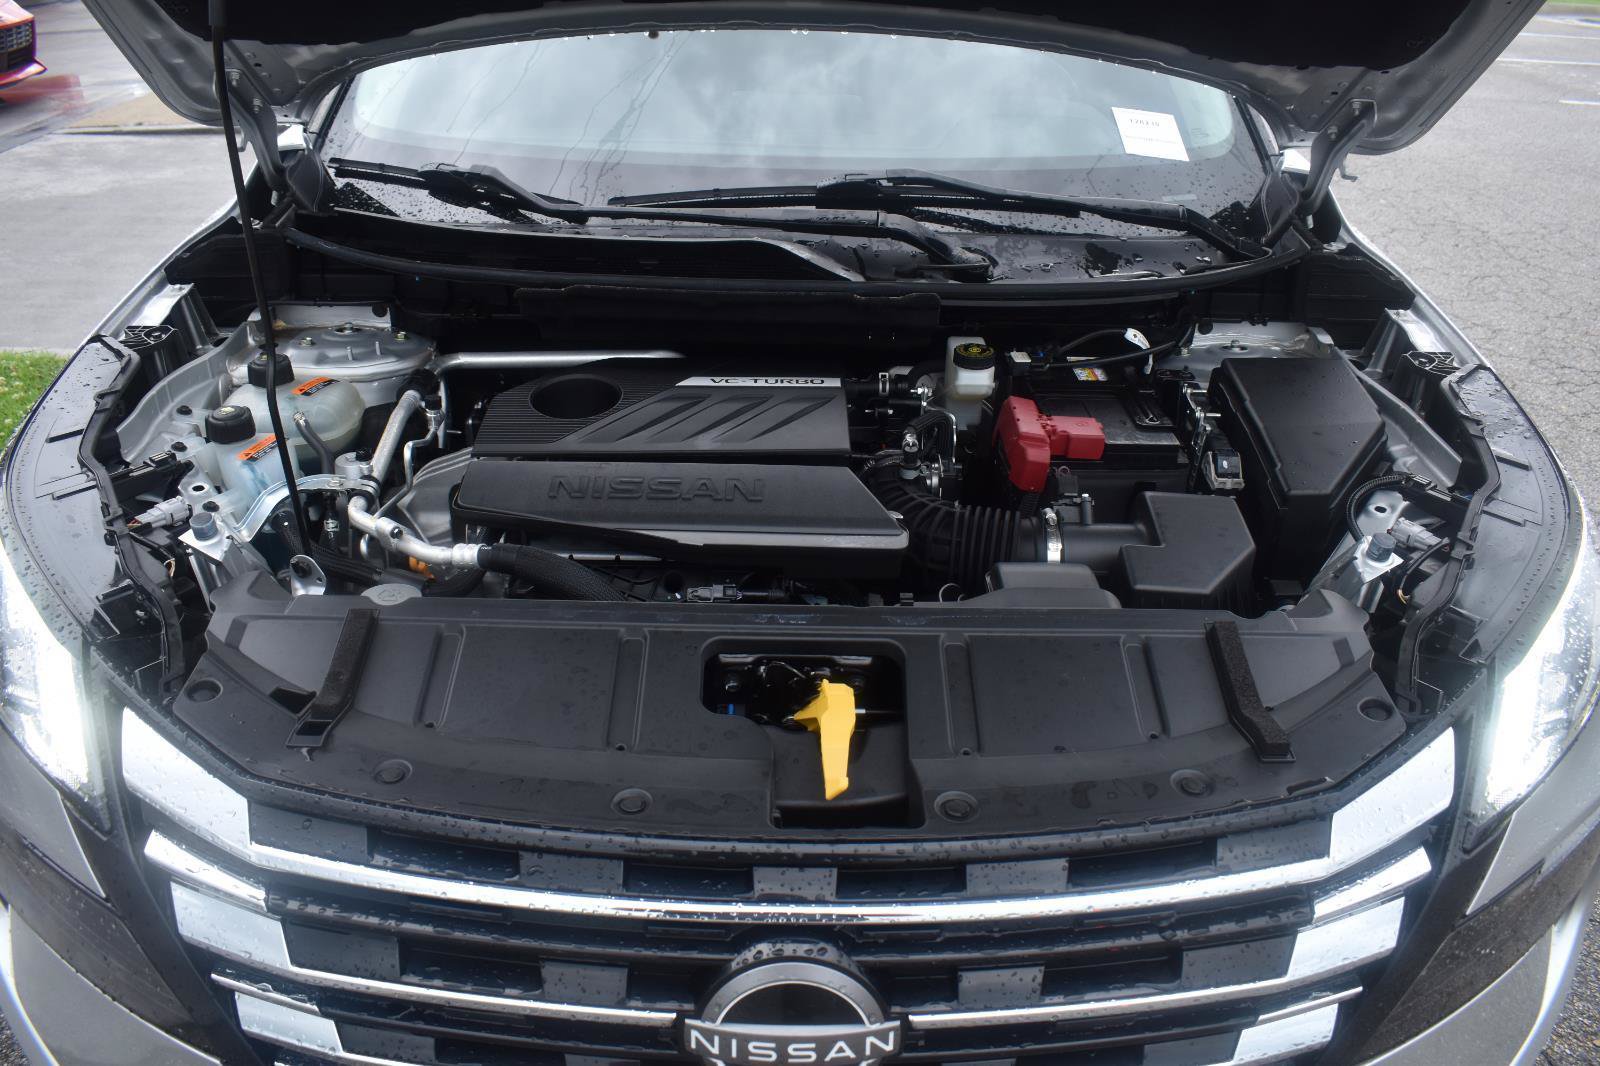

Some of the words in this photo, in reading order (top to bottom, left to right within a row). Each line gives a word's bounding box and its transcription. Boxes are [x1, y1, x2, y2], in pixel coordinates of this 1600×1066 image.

[708, 377, 826, 386] VC-TURBO
[547, 476, 764, 502] NISSAN
[689, 1028, 896, 1064] NISSAN
